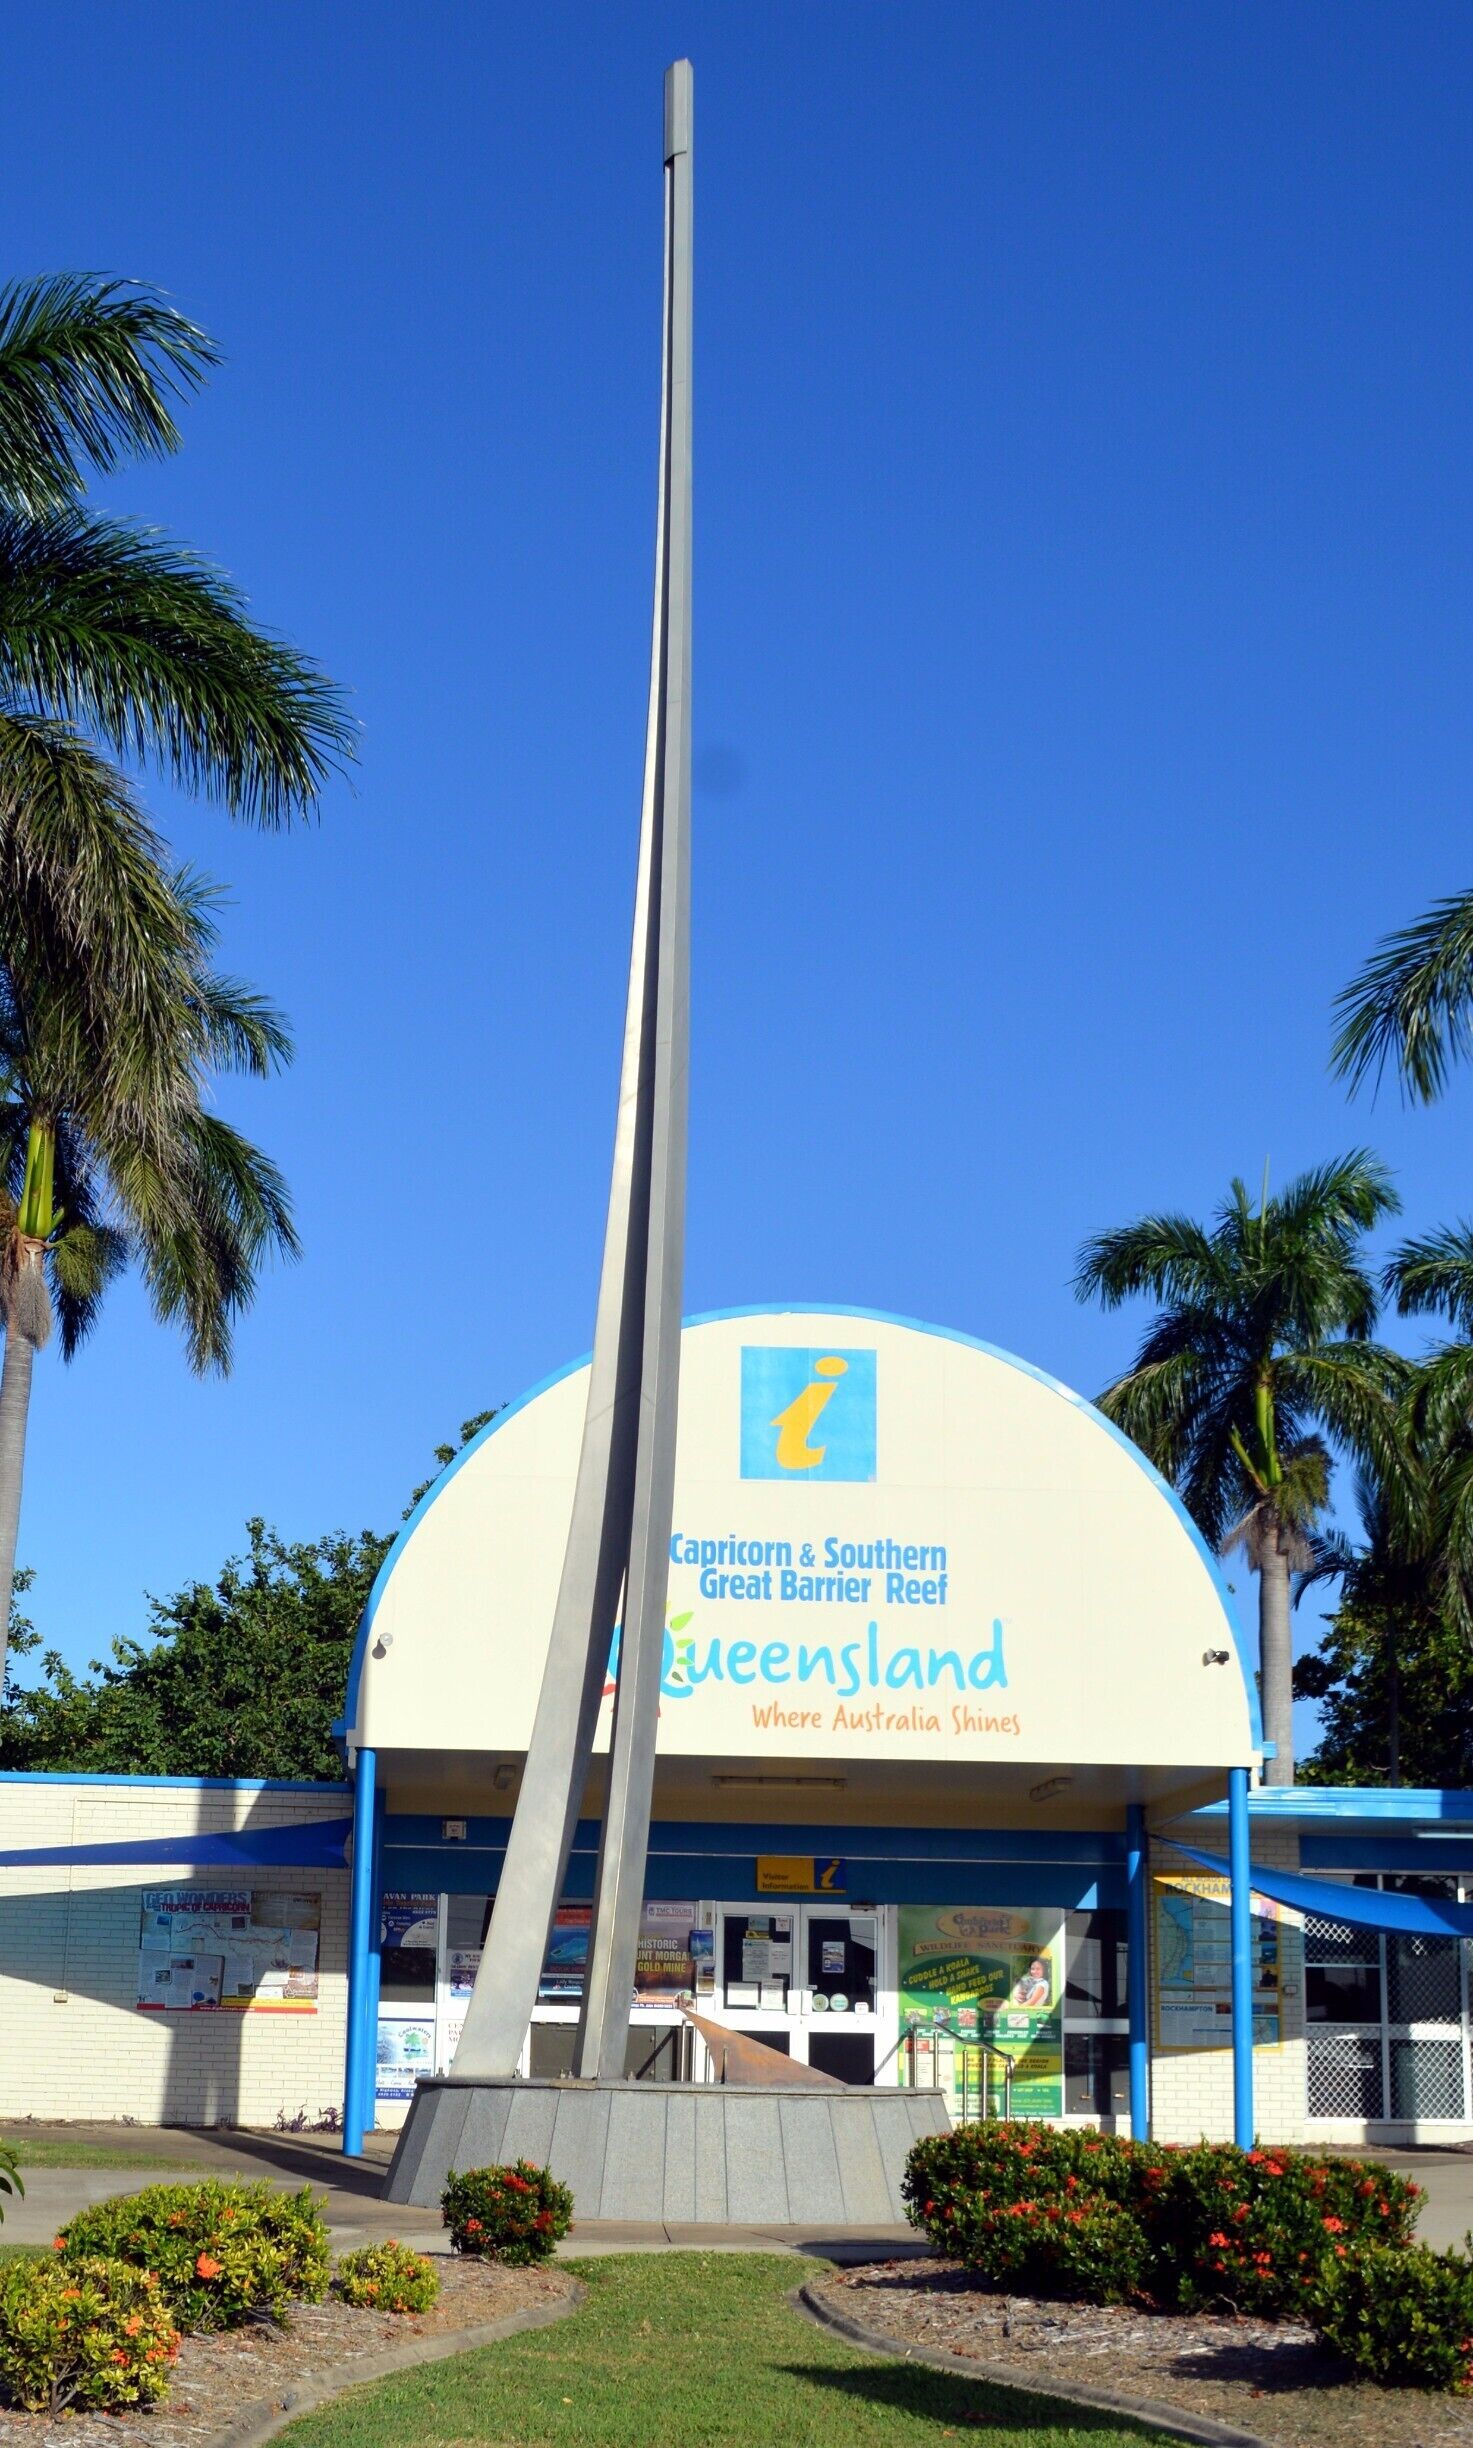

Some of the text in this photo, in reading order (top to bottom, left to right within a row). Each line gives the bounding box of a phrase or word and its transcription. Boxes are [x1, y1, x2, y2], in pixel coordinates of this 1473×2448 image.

[670, 1533, 946, 1570] Capricorn & Southern
[700, 1568, 948, 1605] Great Barrier Reef
[752, 1700, 1020, 1735] Where Australia Shines
[146, 1892, 247, 1904] GEO WONDERS
[639, 1939, 678, 1949] HISTORIC
[920, 1942, 1041, 1952] WILDLIFE SANCTUARY
[638, 1962, 686, 1972] GOLD MINE
[656, 1951, 690, 1961] MORGA
[908, 1957, 970, 1984] CUDDLE A KOALA
[928, 1976, 948, 1989] HOLD
[956, 1965, 980, 1980] SNAKE
[946, 1970, 1004, 1996] HAND FEED OUR
[950, 1984, 994, 2005] KANGAROOS
